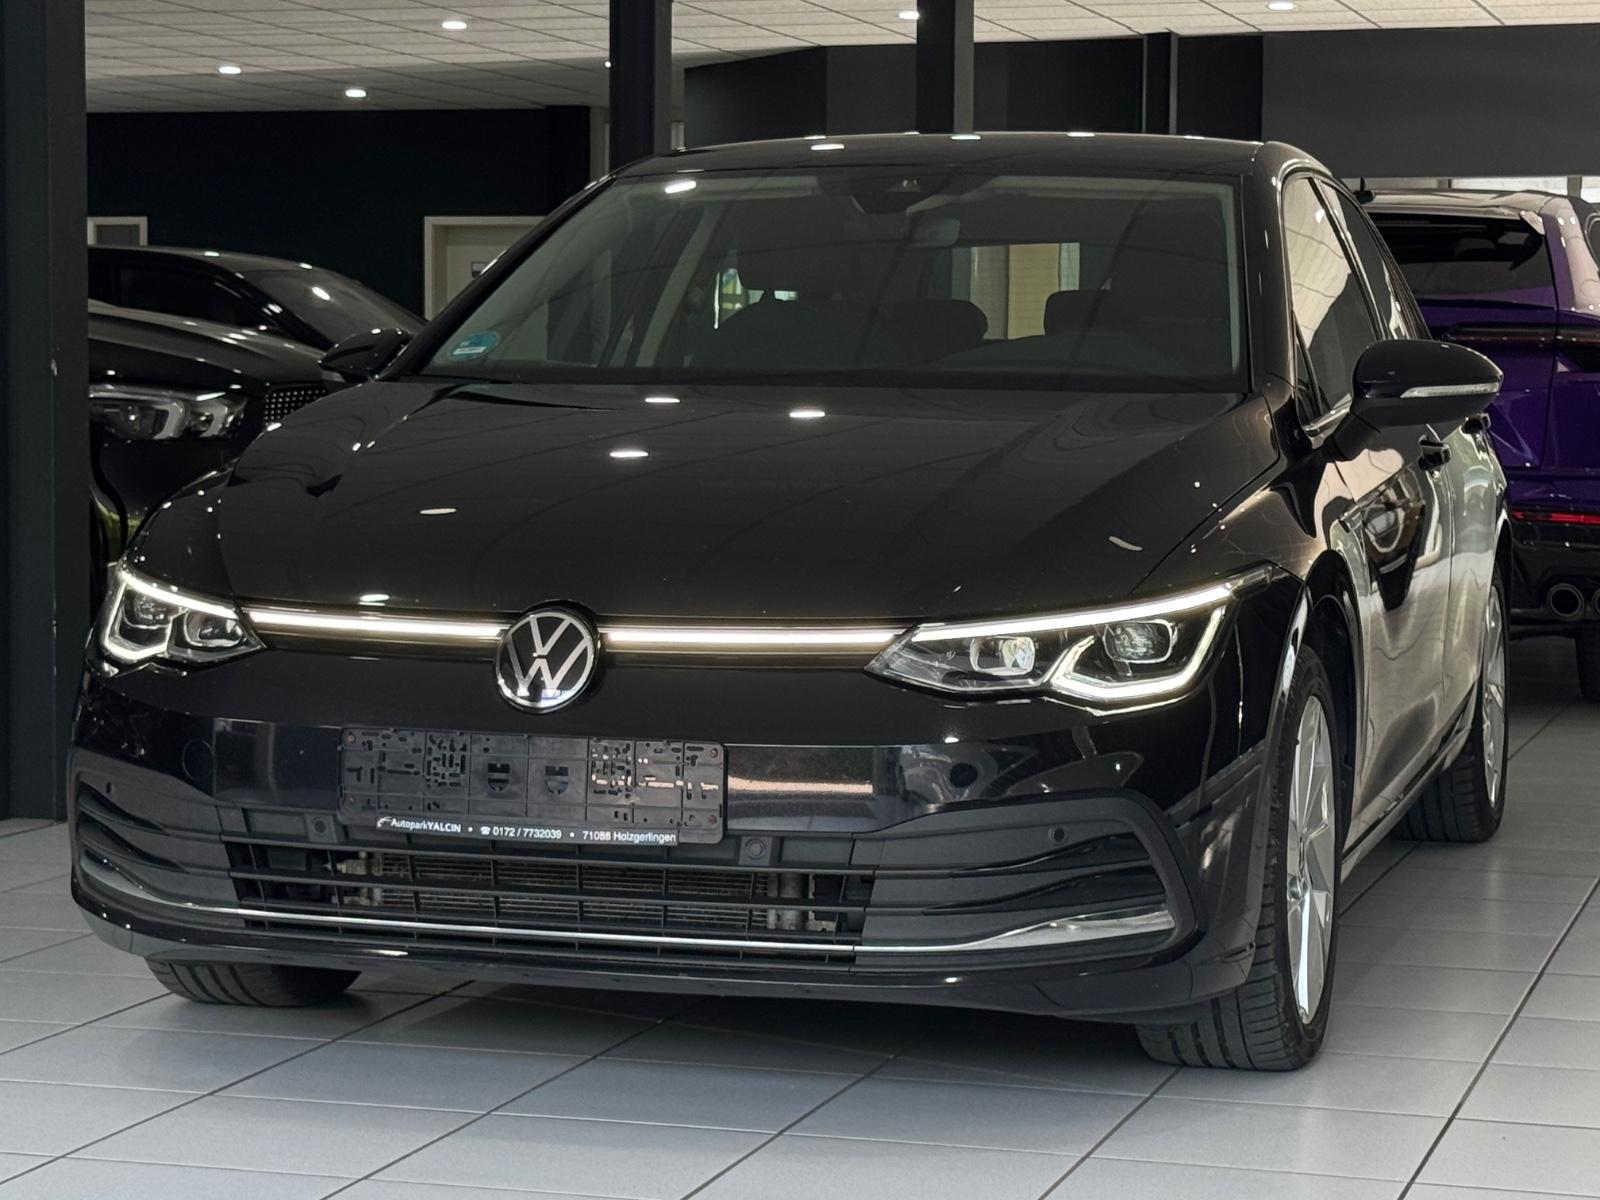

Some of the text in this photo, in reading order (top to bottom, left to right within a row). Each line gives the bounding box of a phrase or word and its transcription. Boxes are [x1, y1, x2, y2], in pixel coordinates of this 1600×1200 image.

[492, 826, 516, 837] 0172
[522, 828, 562, 840] 7732039
[582, 830, 612, 841] 71088
[613, 831, 676, 844] Holzgerlingen
